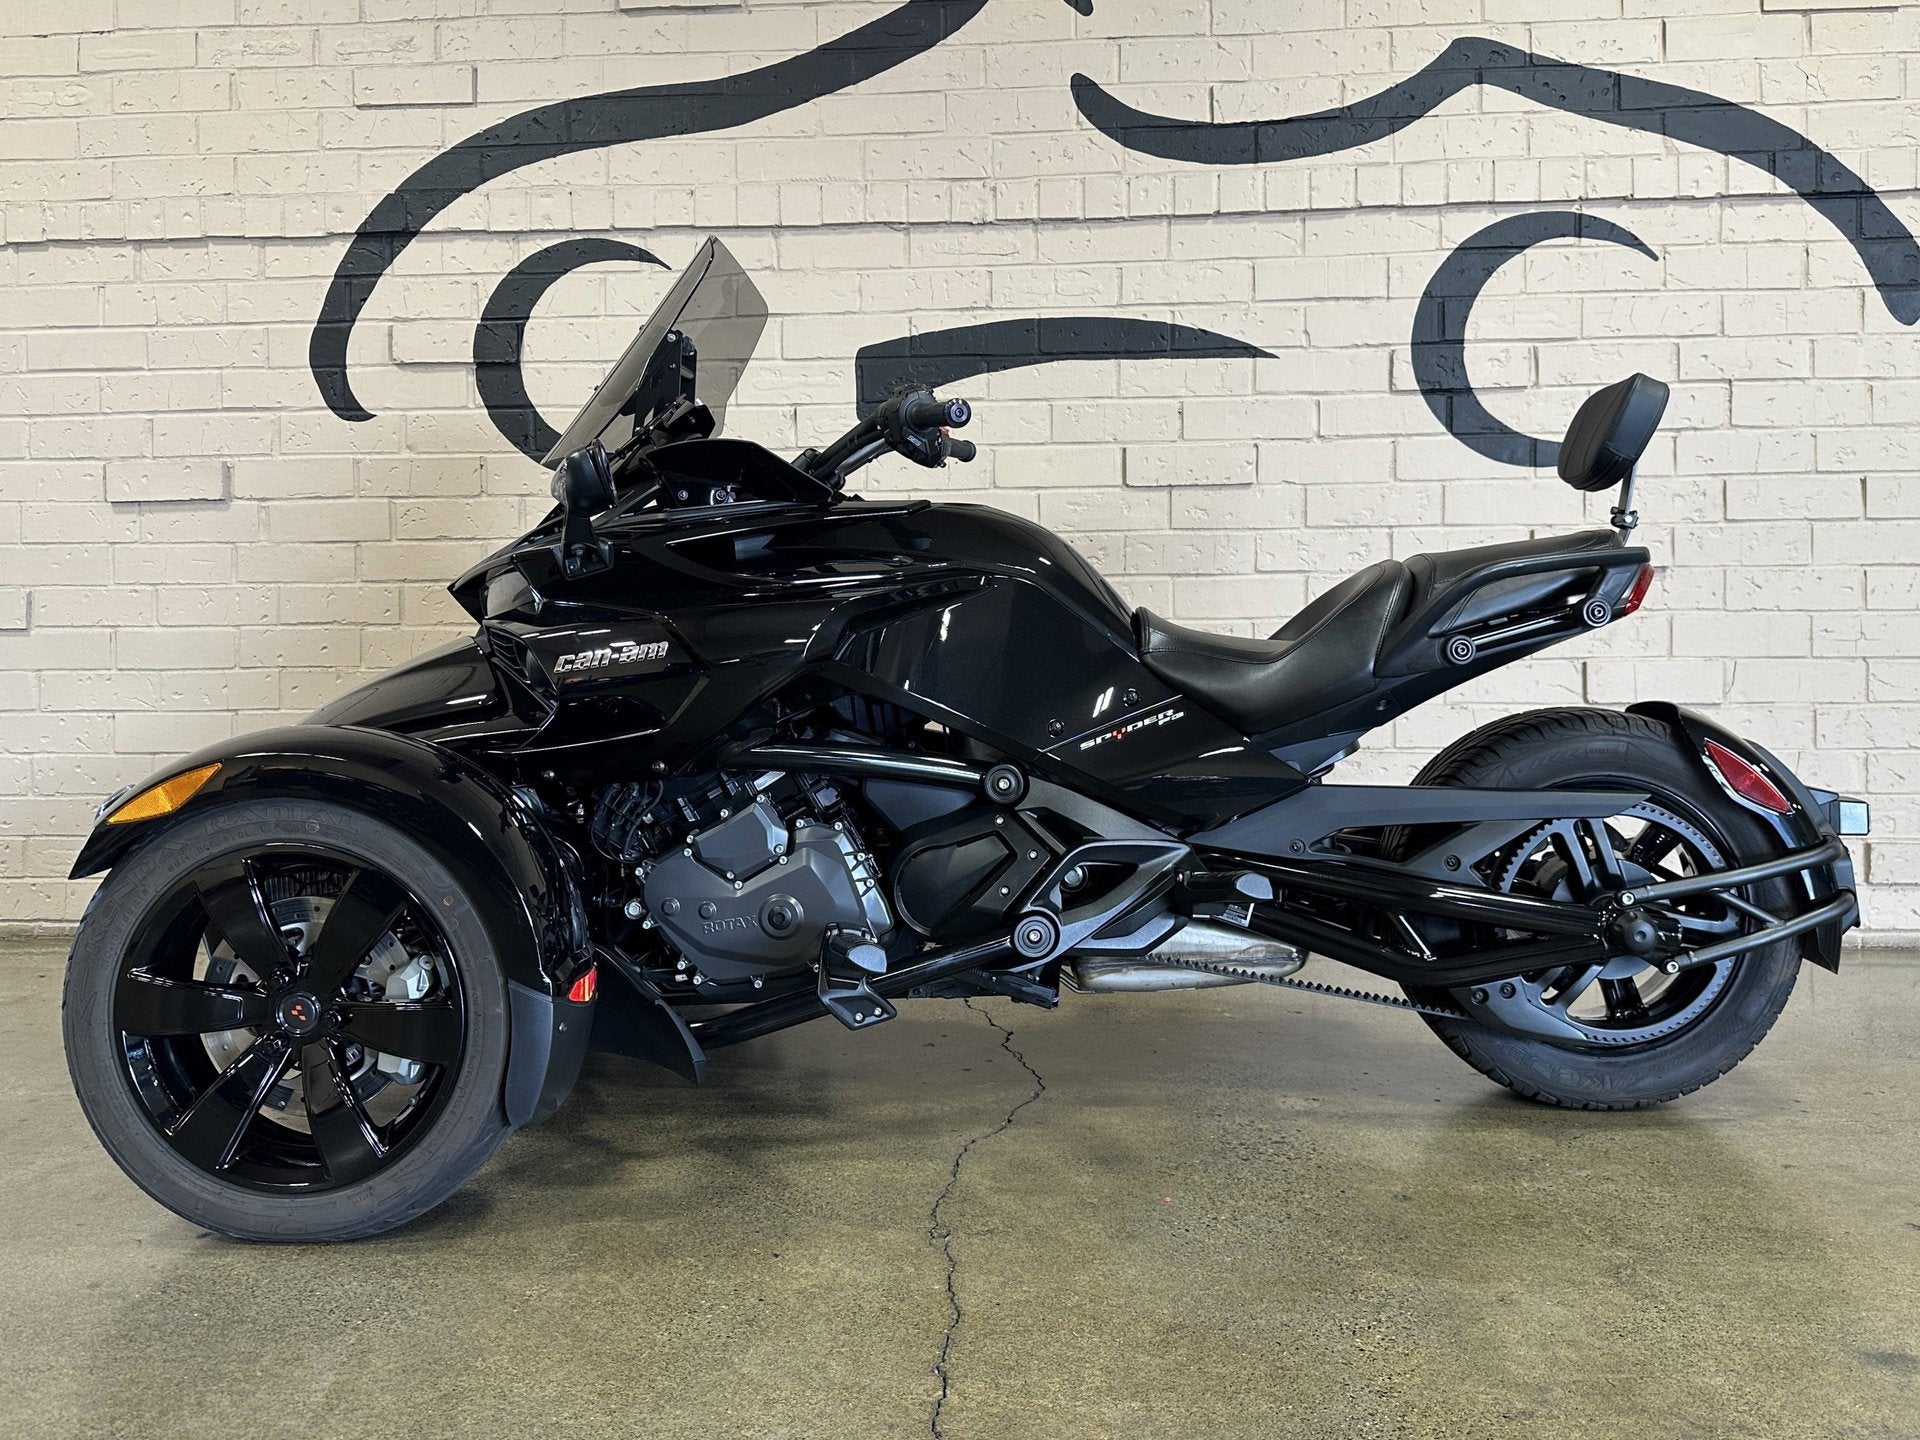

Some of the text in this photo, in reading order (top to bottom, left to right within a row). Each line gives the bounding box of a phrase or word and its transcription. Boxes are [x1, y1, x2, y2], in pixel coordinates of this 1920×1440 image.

[1080, 709, 1174, 750] SPYDER
[86, 838, 189, 956] KENDA
[203, 804, 360, 836] RADIAL
[702, 914, 760, 934] ROTAX
